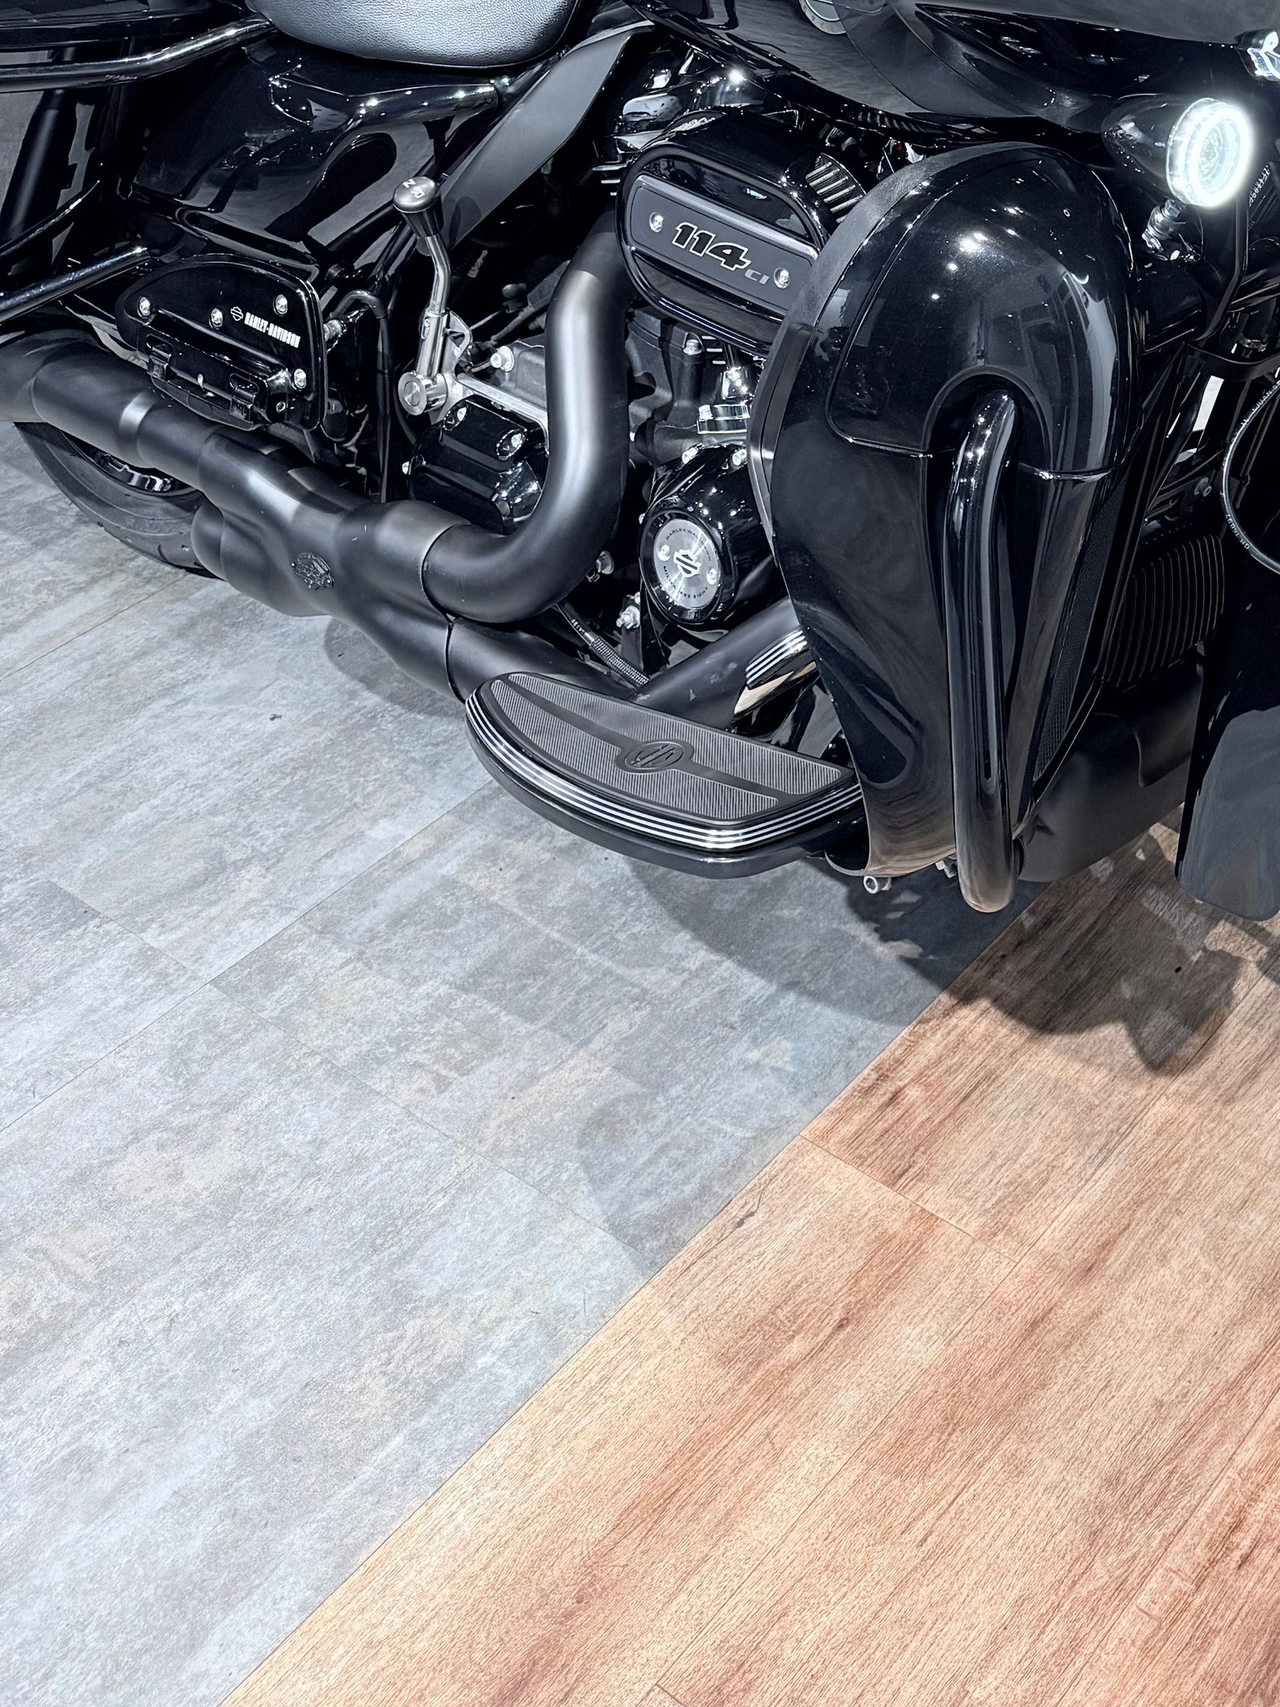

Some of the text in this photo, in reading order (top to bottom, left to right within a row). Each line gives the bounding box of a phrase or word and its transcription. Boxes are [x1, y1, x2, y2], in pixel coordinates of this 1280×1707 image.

[671, 221, 770, 285] 114 CI
[245, 311, 301, 348] HARLEY-DAVIDSON
